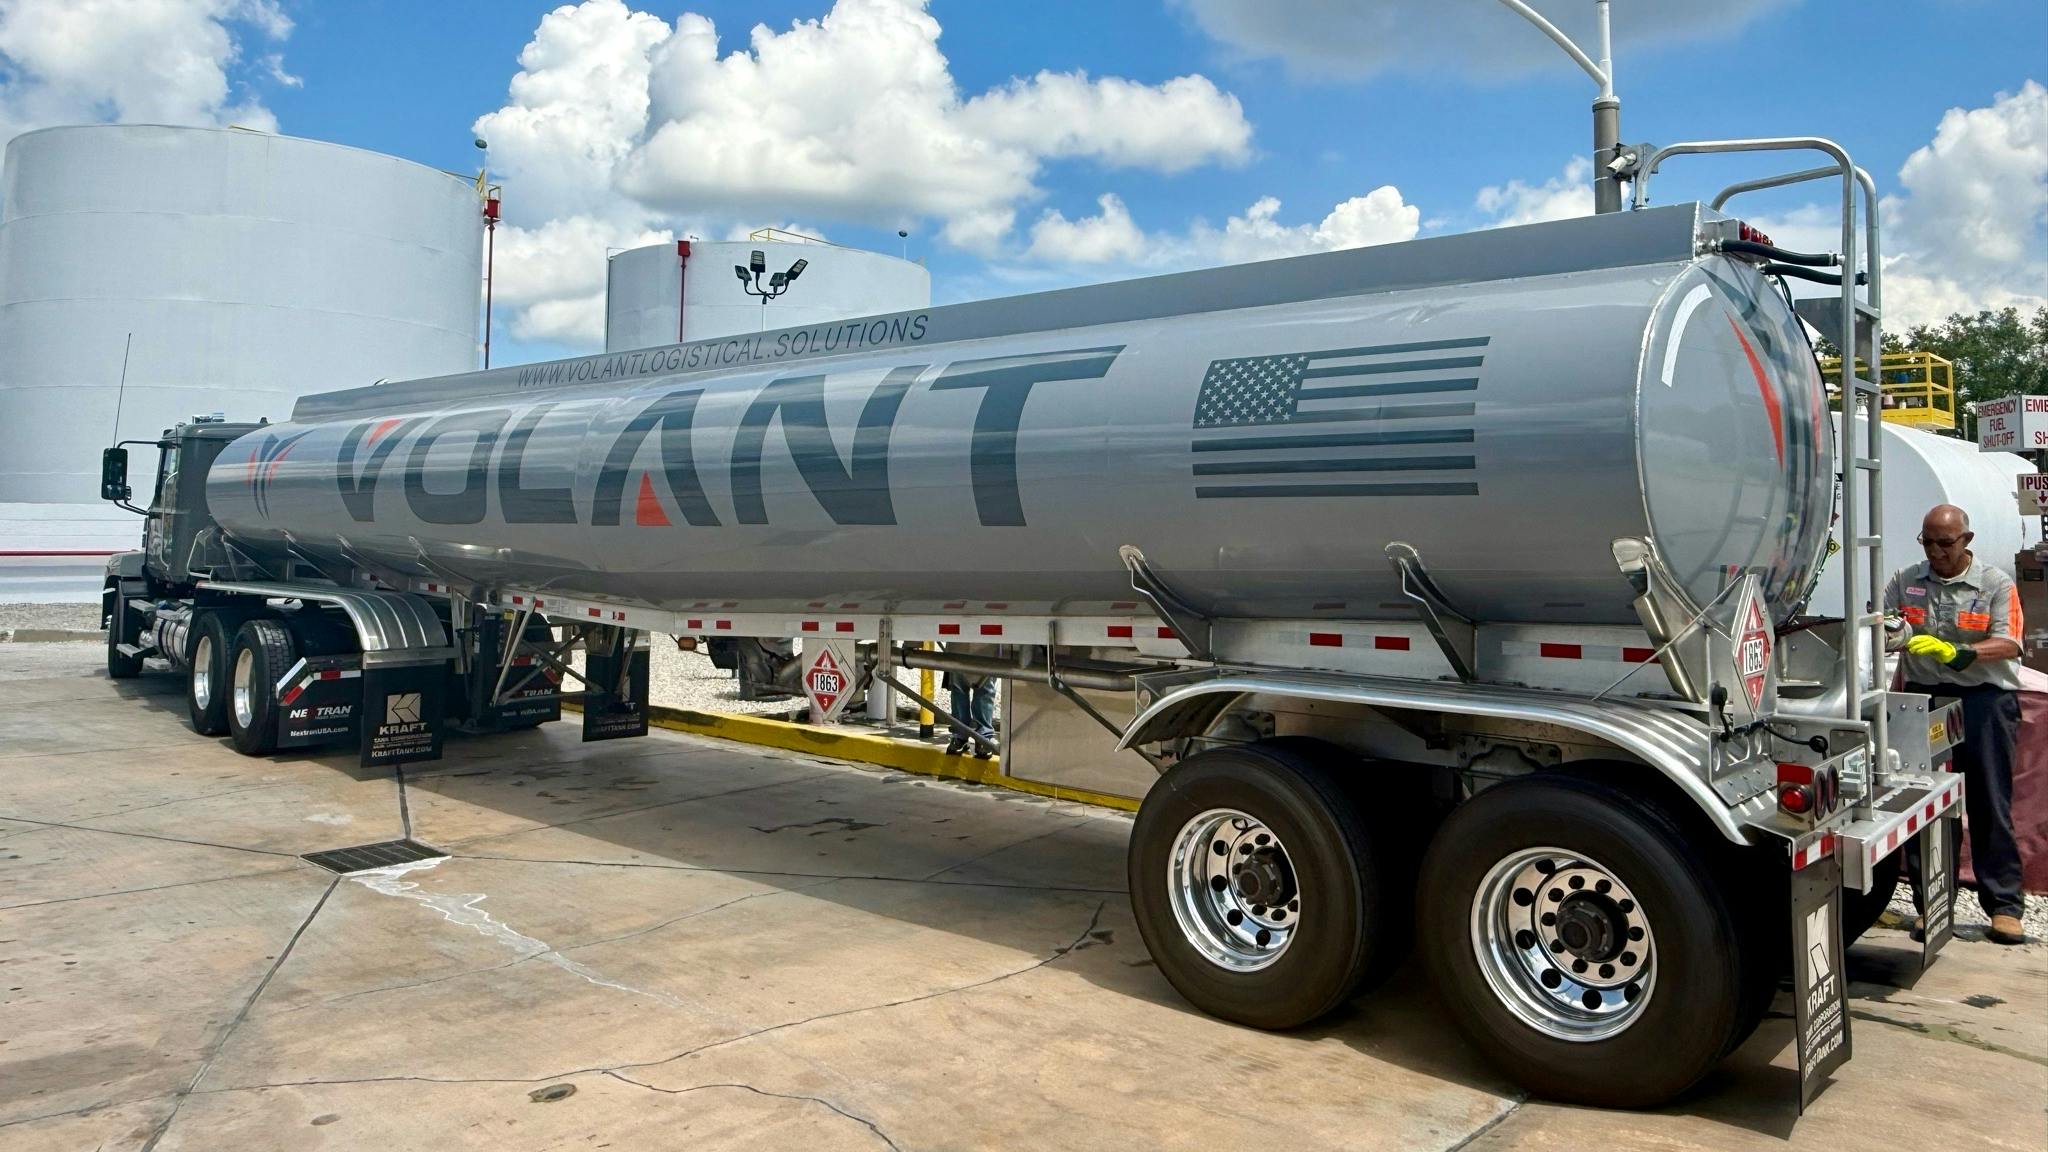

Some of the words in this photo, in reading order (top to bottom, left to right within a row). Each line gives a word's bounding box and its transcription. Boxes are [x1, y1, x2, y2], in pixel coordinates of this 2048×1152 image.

[518, 314, 930, 388] WWW.VOLANTLOGISTICAL.SOLUTIONS
[1977, 398, 2017, 418] EMERGENCY
[1989, 417, 2006, 433] FUEL
[336, 345, 1127, 527] VOLANT
[1983, 431, 2015, 449] SHUT-OFF
[1744, 639, 1763, 673] 1863
[815, 674, 838, 692] 1863
[1752, 683, 1757, 698] 3
[823, 698, 828, 707] 3
[379, 722, 428, 736] KRAFT
[372, 746, 432, 758] KRAFTTANK.COM
[1807, 974, 1835, 1020] KRAFT
[1813, 997, 1841, 1032] CORPORATION
